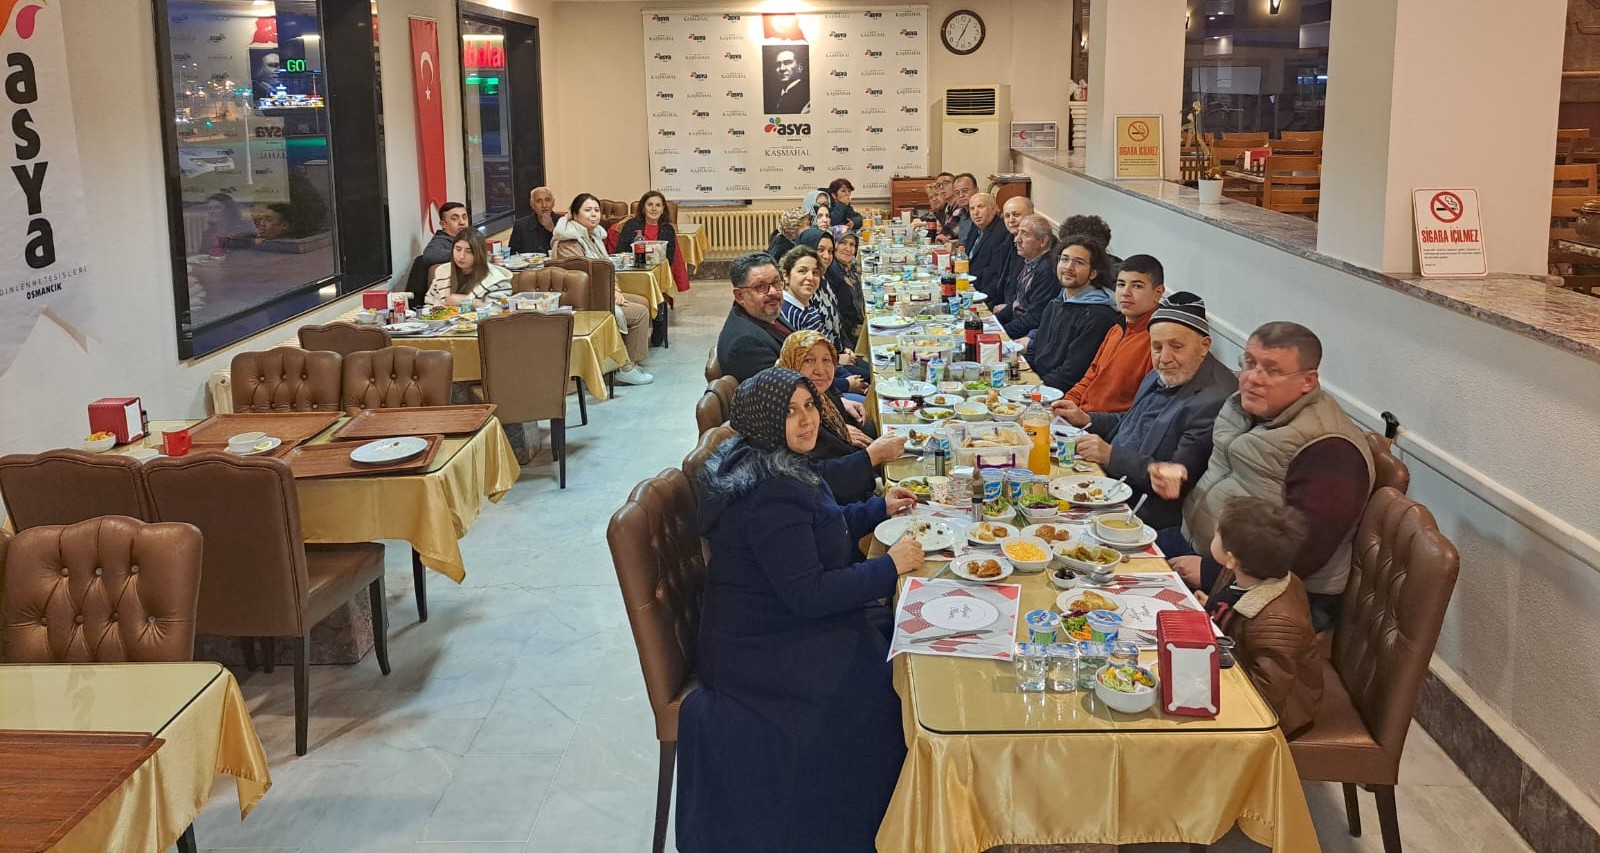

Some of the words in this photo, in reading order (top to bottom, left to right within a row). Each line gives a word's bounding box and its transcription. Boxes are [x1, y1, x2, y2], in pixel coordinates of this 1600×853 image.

[777, 123, 811, 135] asya
[1421, 227, 1449, 243] SİGARA
[1450, 226, 1480, 244] İÇİLMEZ
[27, 282, 62, 300] OSMANCIK
